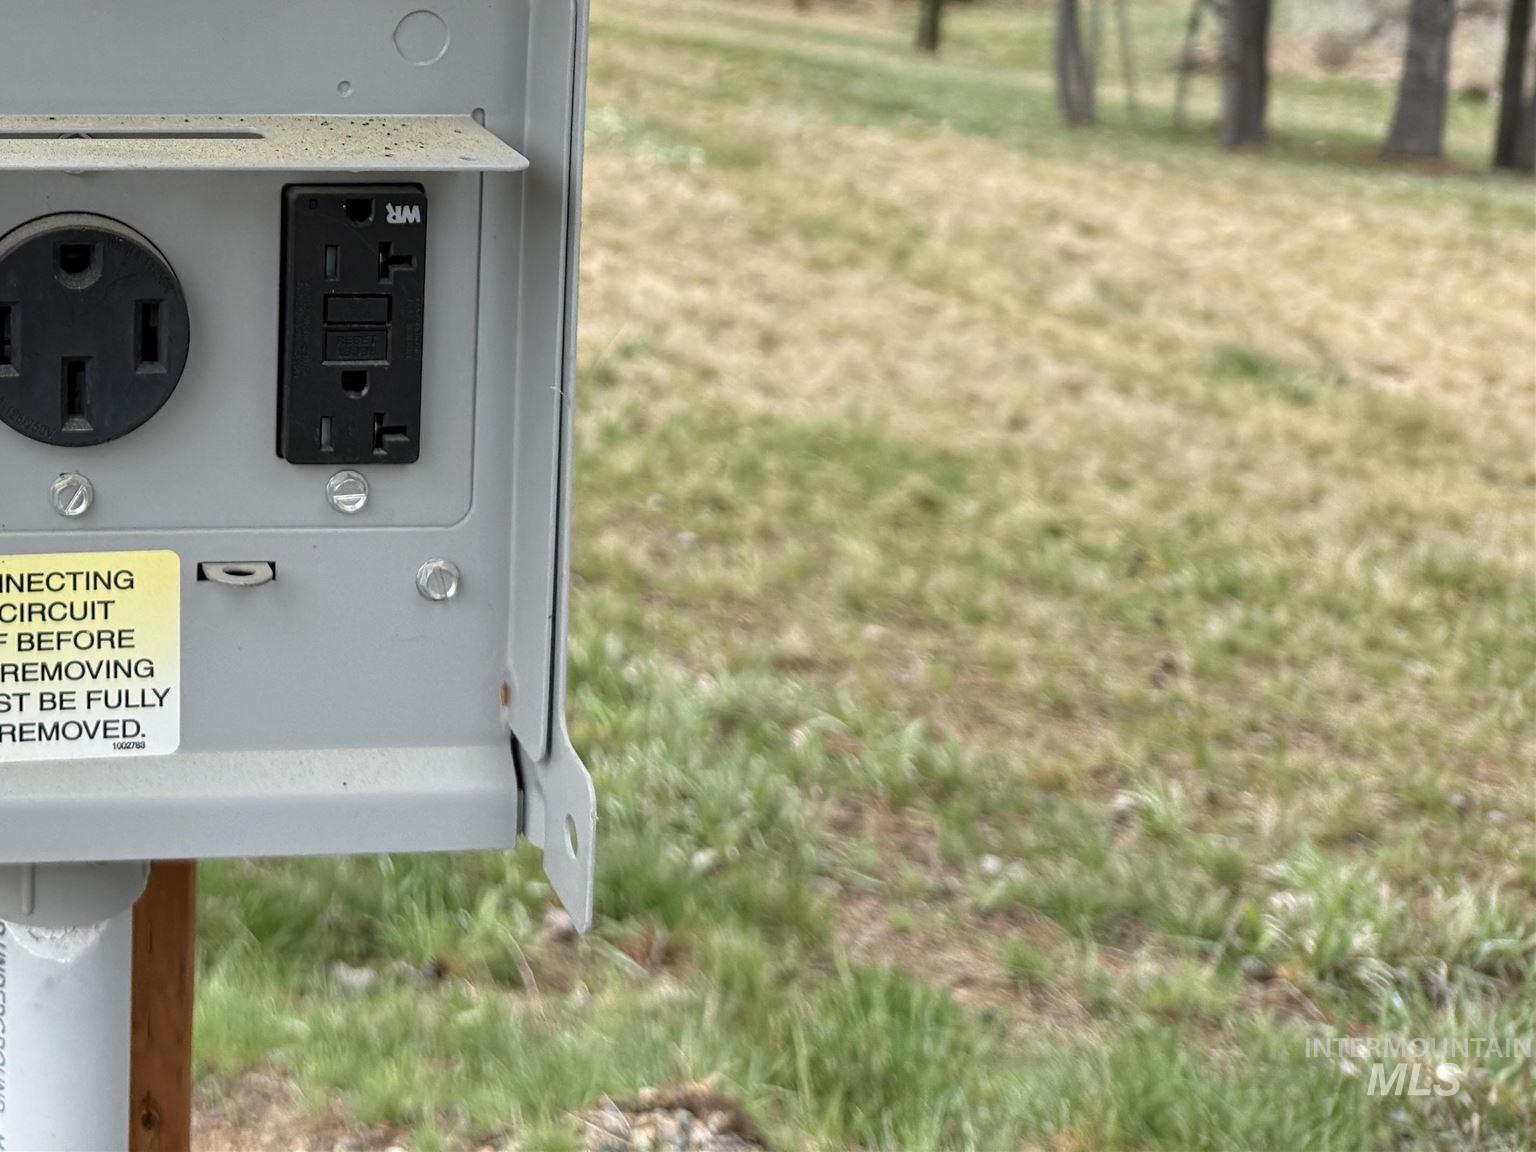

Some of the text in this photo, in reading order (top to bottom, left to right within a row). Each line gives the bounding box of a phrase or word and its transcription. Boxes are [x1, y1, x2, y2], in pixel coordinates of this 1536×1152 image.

[384, 202, 421, 224] WR
[18, 628, 135, 652] BEFORE
[0, 658, 154, 683] REMOVING
[39, 690, 76, 712] BE
[86, 687, 171, 710] FULLY
